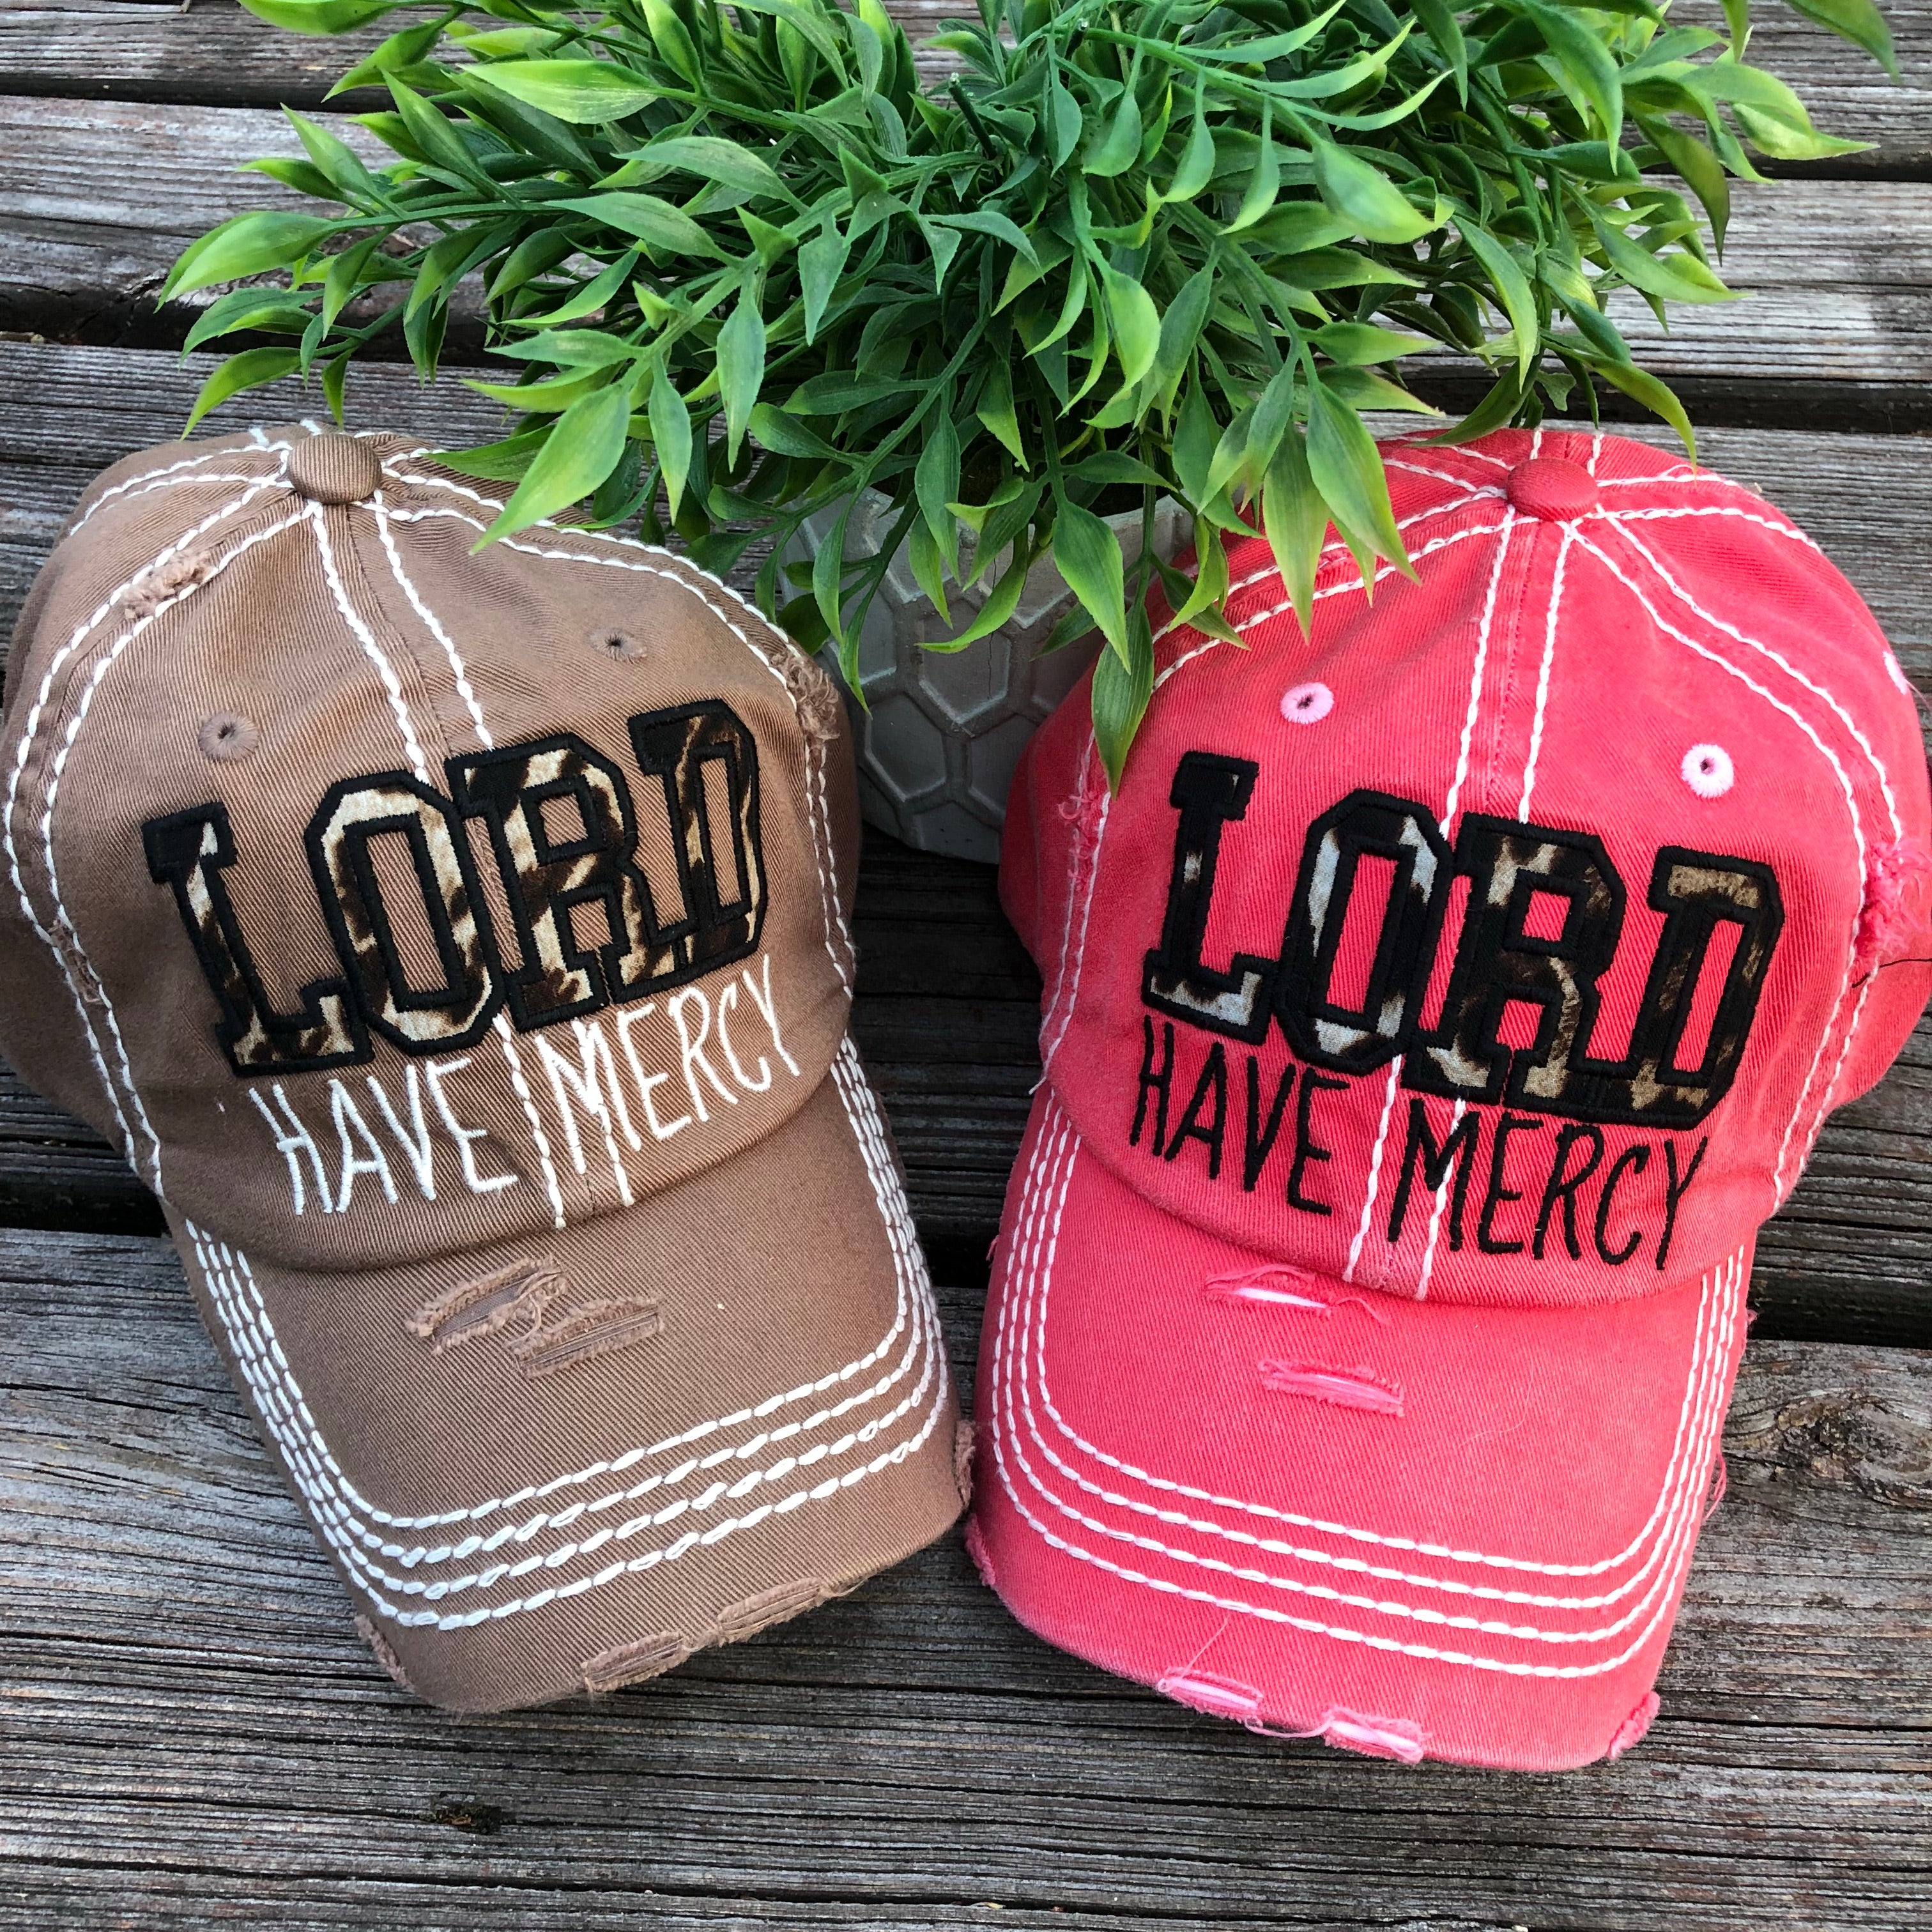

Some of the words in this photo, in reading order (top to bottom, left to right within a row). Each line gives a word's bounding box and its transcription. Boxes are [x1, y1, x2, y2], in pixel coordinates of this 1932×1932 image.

[142, 698, 767, 1077] LORD
[1142, 751, 1784, 1130] LORD
[249, 1059, 518, 1215] HAVE
[535, 953, 800, 1174] MERCY
[1130, 1016, 1351, 1216] HAVE
[1388, 1098, 1708, 1270] MERCY
